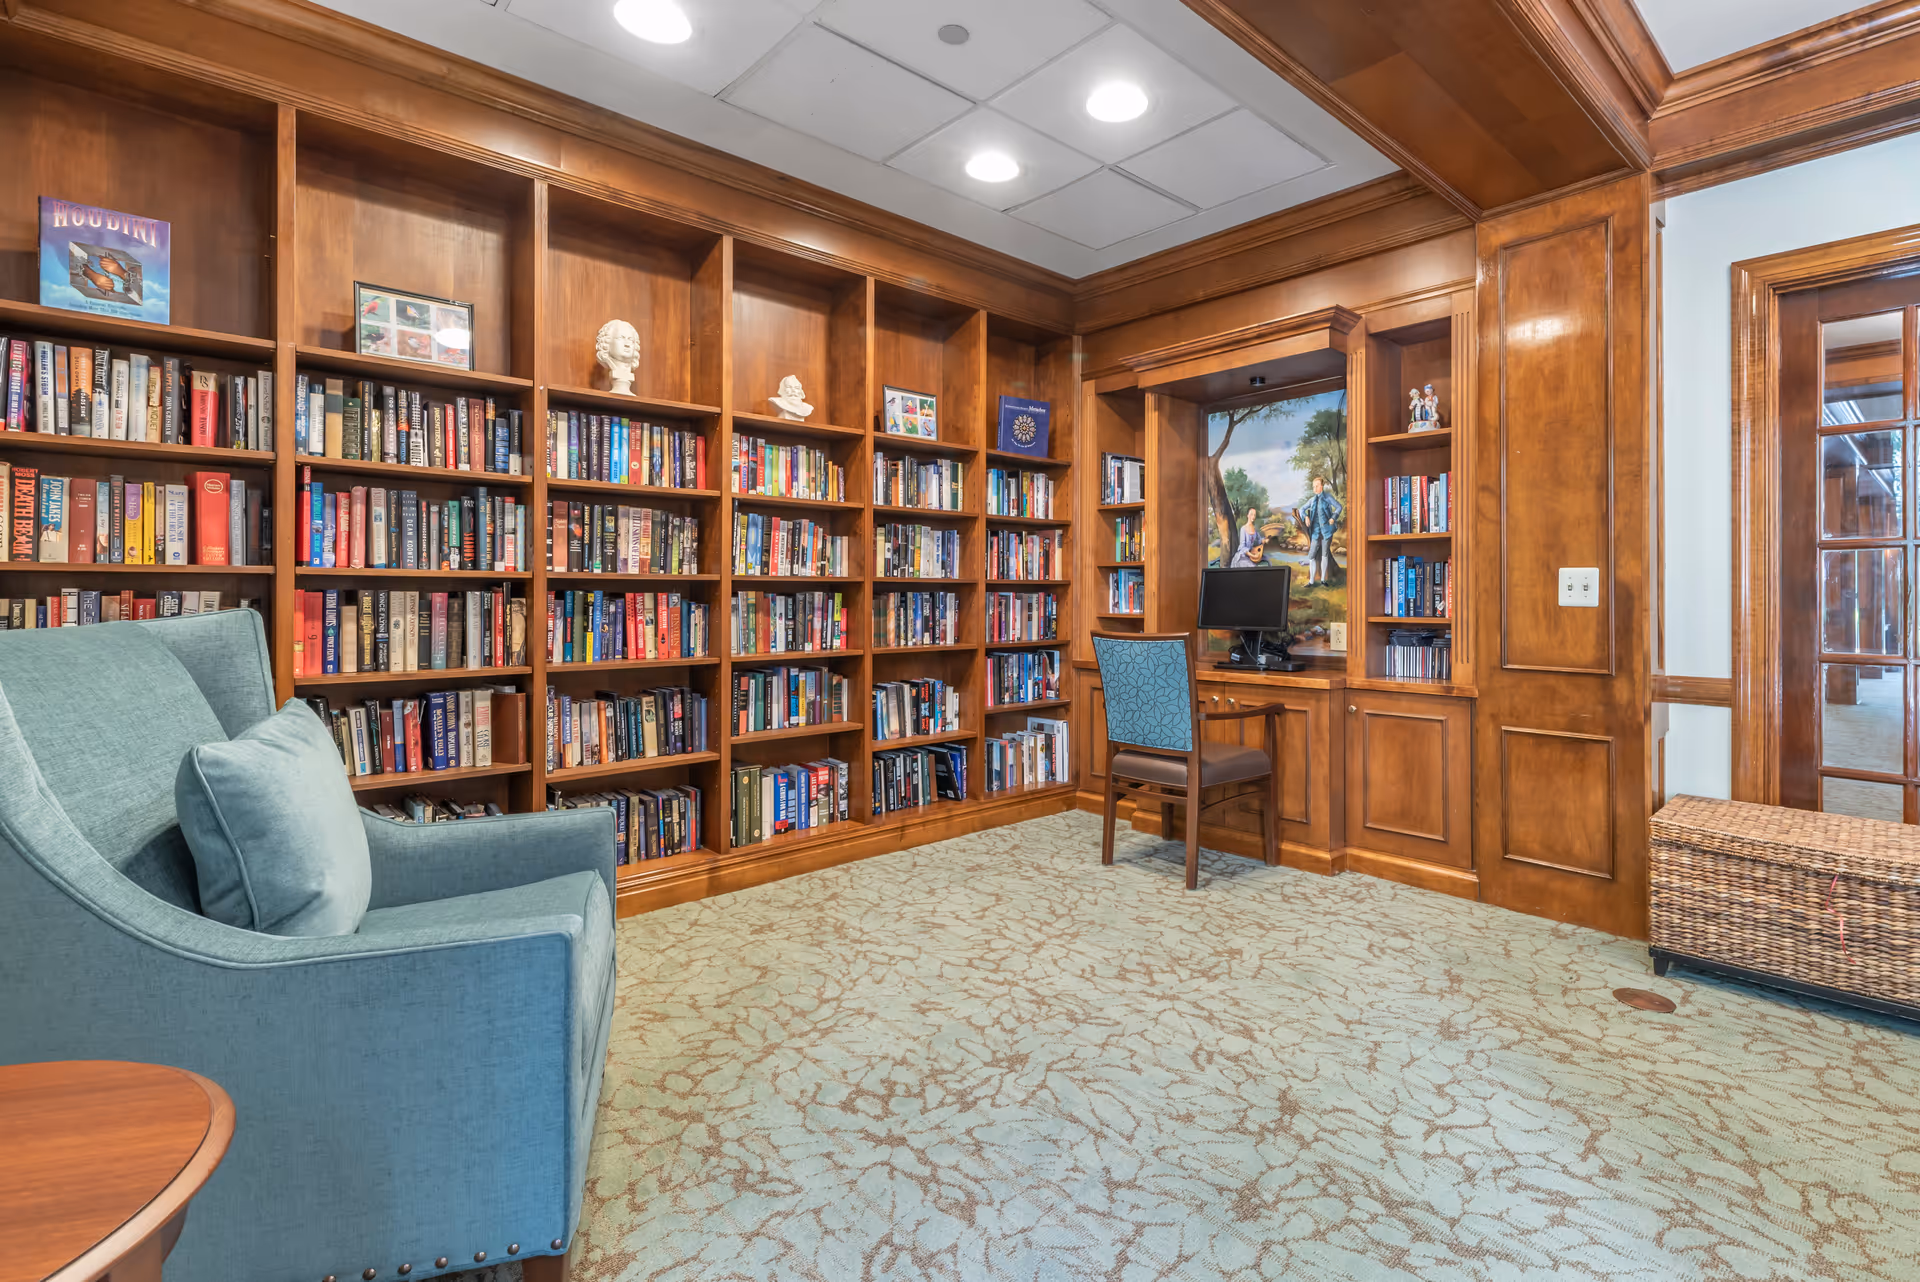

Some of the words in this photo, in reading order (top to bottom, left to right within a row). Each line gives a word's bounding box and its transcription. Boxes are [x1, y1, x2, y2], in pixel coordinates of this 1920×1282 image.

[53, 200, 157, 248] HOUDINI
[95, 349, 107, 366] FINAL
[165, 361, 173, 371] THE
[11, 372, 21, 393] WRIGHT
[95, 366, 107, 385] TARGET
[165, 372, 173, 392] APPEAL
[165, 395, 173, 411] JOHN
[433, 407, 441, 421] JAMES
[15, 478, 36, 517] DEATH
[49, 480, 62, 501] JOHN
[41, 484, 49, 518] Homeland
[128, 502, 137, 517] Help
[48, 501, 61, 522] JAKES
[406, 519, 414, 536] DEAN
[406, 540, 414, 563] KOONTZ
[631, 555, 640, 569] LOVE
[164, 595, 172, 616] CUSSLER
[325, 592, 337, 609] TERM
[362, 596, 372, 613] ROBERT
[378, 592, 387, 612] VINCE
[635, 595, 644, 622] MAJESTIC
[325, 609, 337, 627] LIMITS
[362, 614, 373, 634] LUDLUM
[378, 613, 387, 633] FLYNN
[327, 636, 335, 649] VINCE
[326, 649, 334, 662] FLYNN
[437, 738, 445, 757] FOLLY
